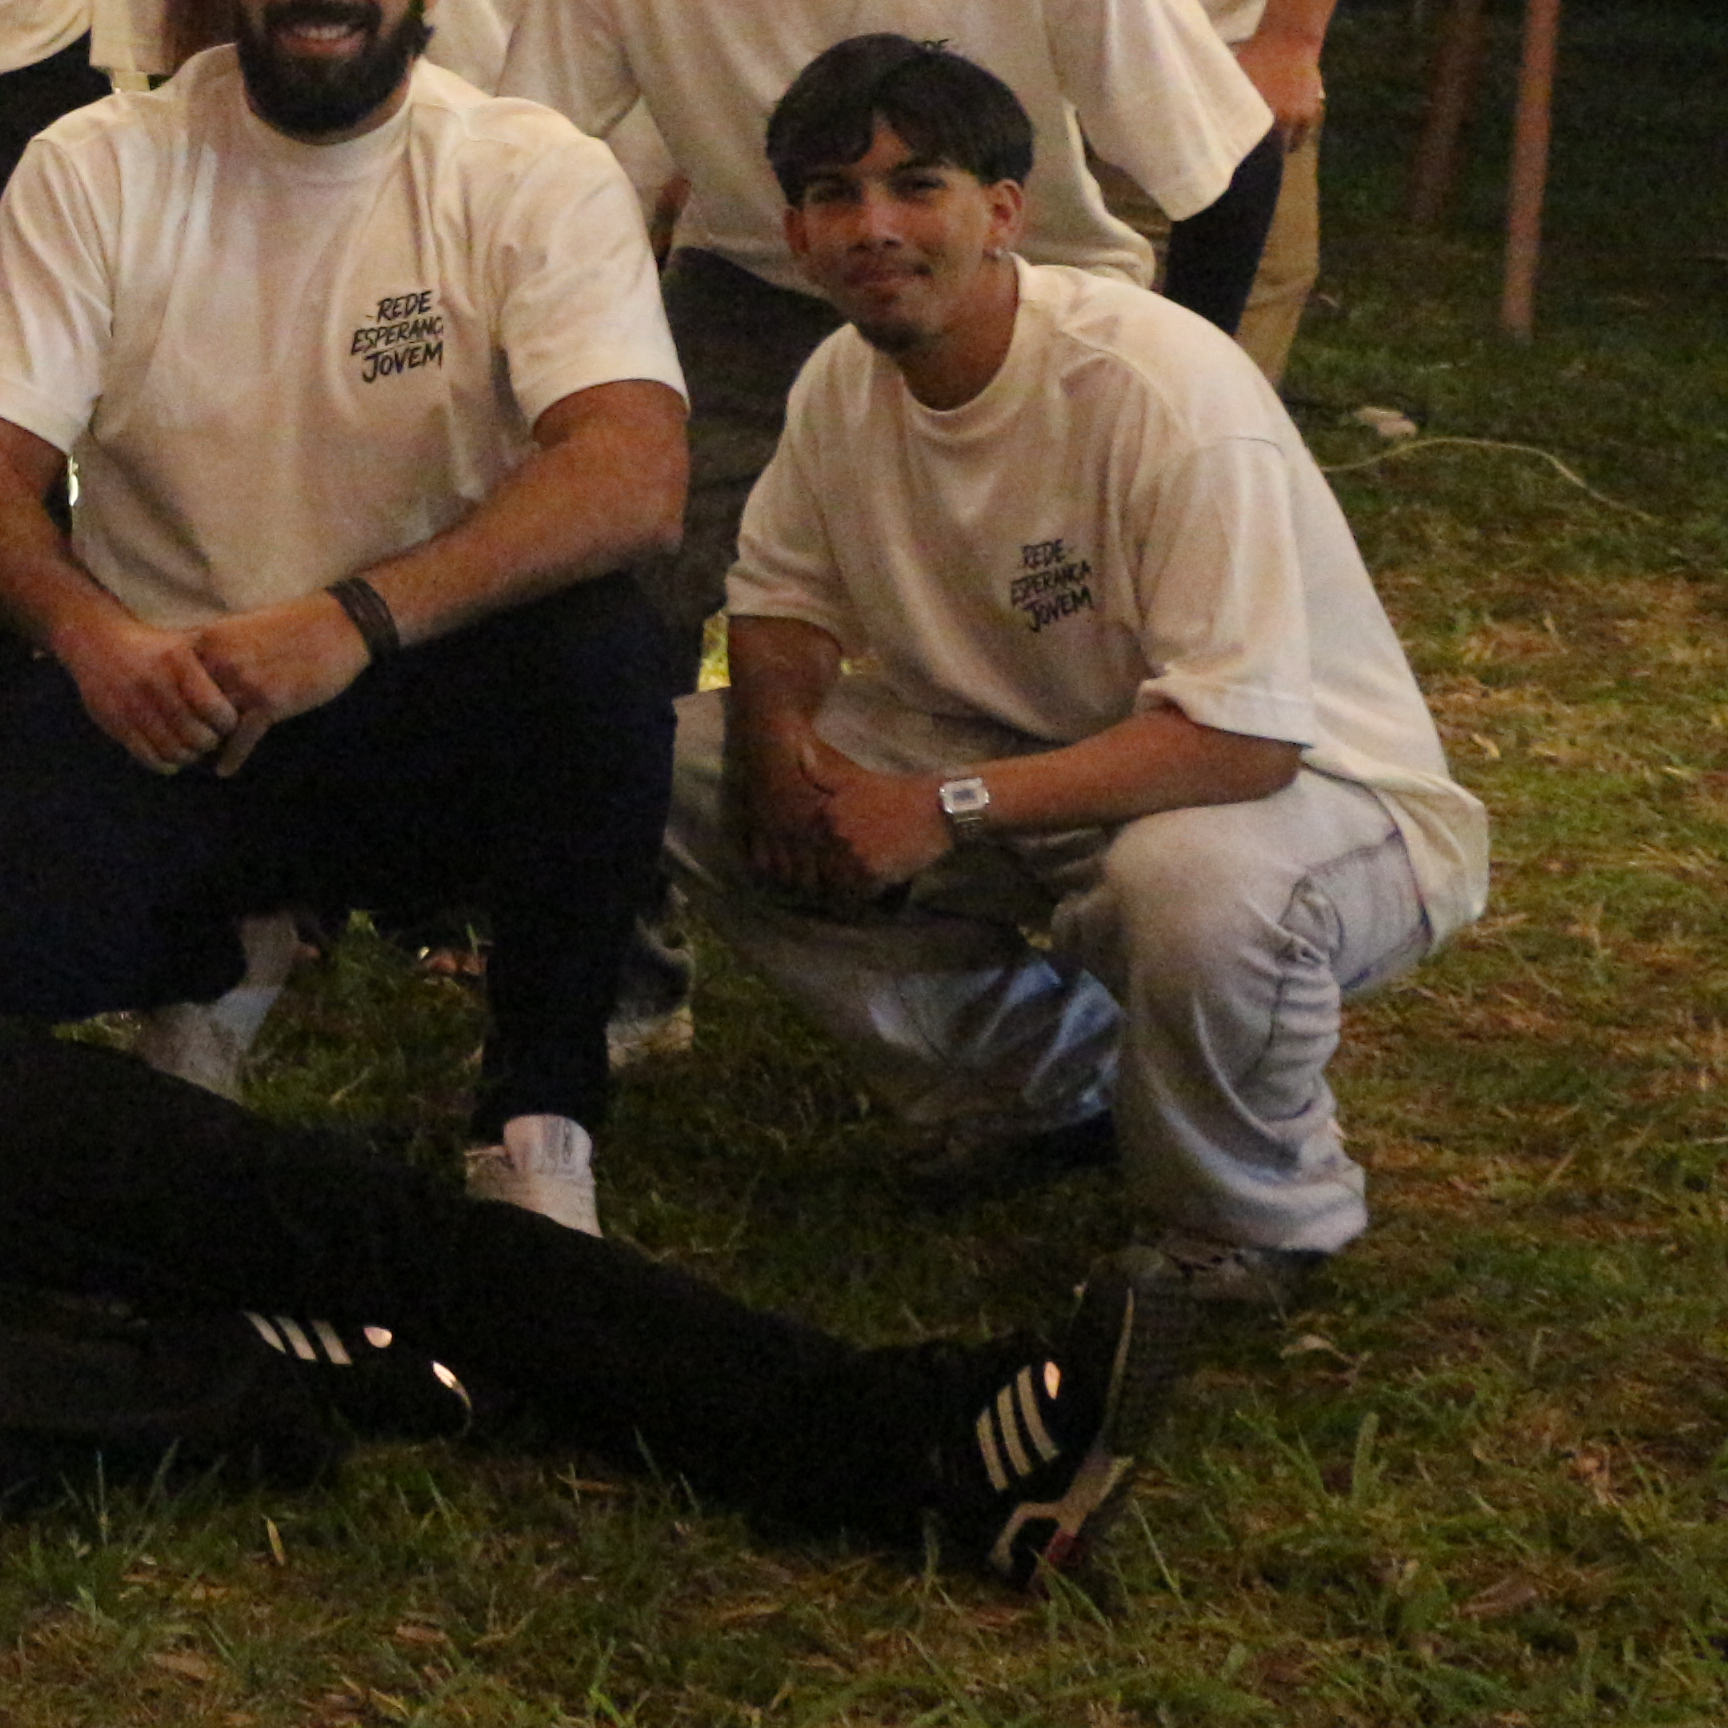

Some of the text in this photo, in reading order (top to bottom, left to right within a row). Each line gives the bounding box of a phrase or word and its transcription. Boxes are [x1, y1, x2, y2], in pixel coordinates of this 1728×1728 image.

[377, 290, 432, 324] REDE
[362, 339, 443, 383] JOVEM
[1021, 538, 1066, 569] REDE
[1023, 585, 1095, 632] JOVEM
